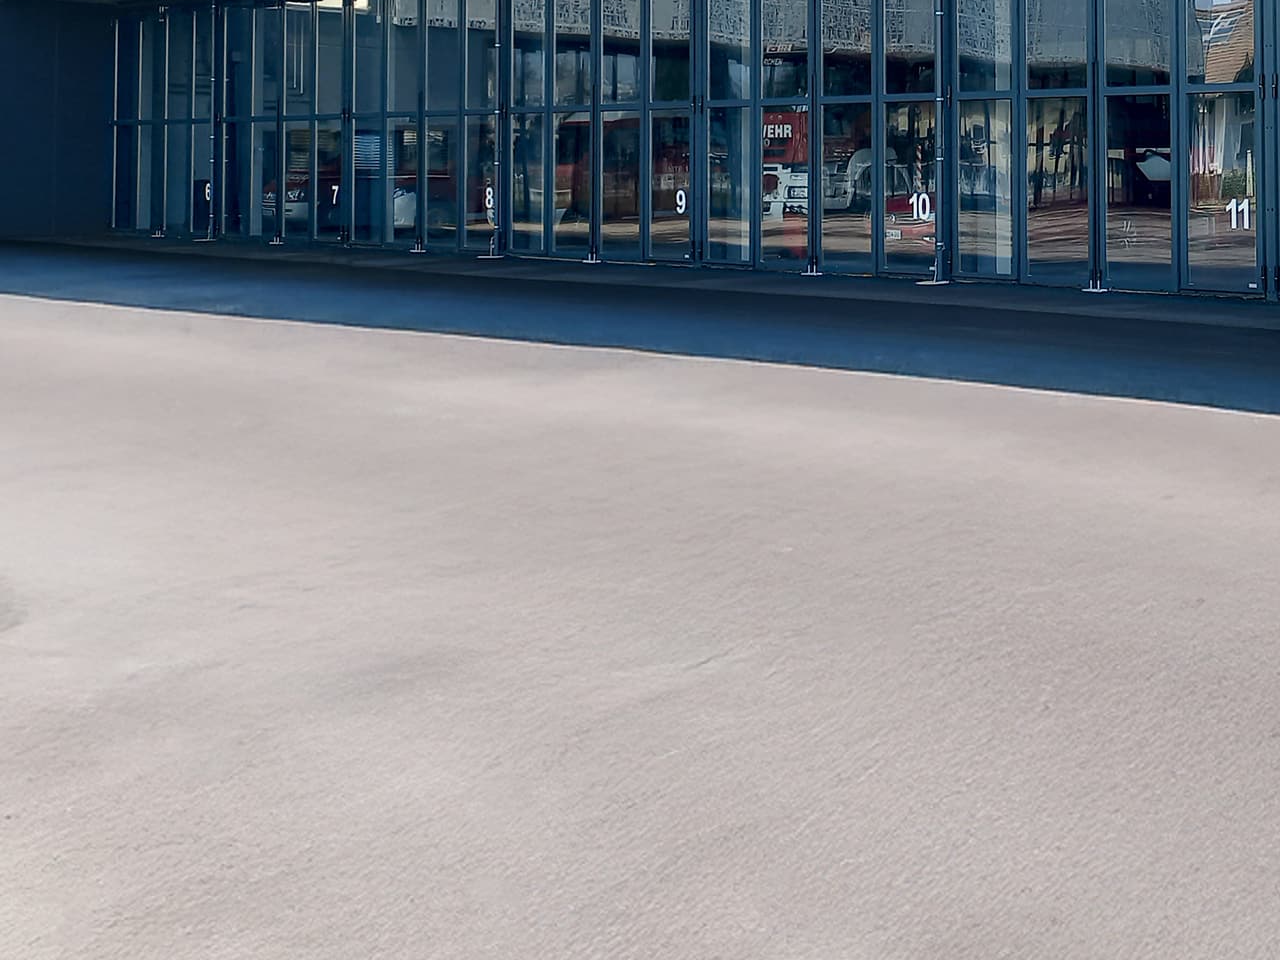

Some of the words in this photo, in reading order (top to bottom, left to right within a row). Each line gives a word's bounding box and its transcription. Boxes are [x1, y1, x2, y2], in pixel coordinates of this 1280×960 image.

[205, 182, 211, 201] 6
[331, 185, 339, 205] 7
[485, 187, 494, 209] 8
[675, 189, 687, 214] 9
[908, 192, 931, 220] 10
[1225, 198, 1250, 230] 11
